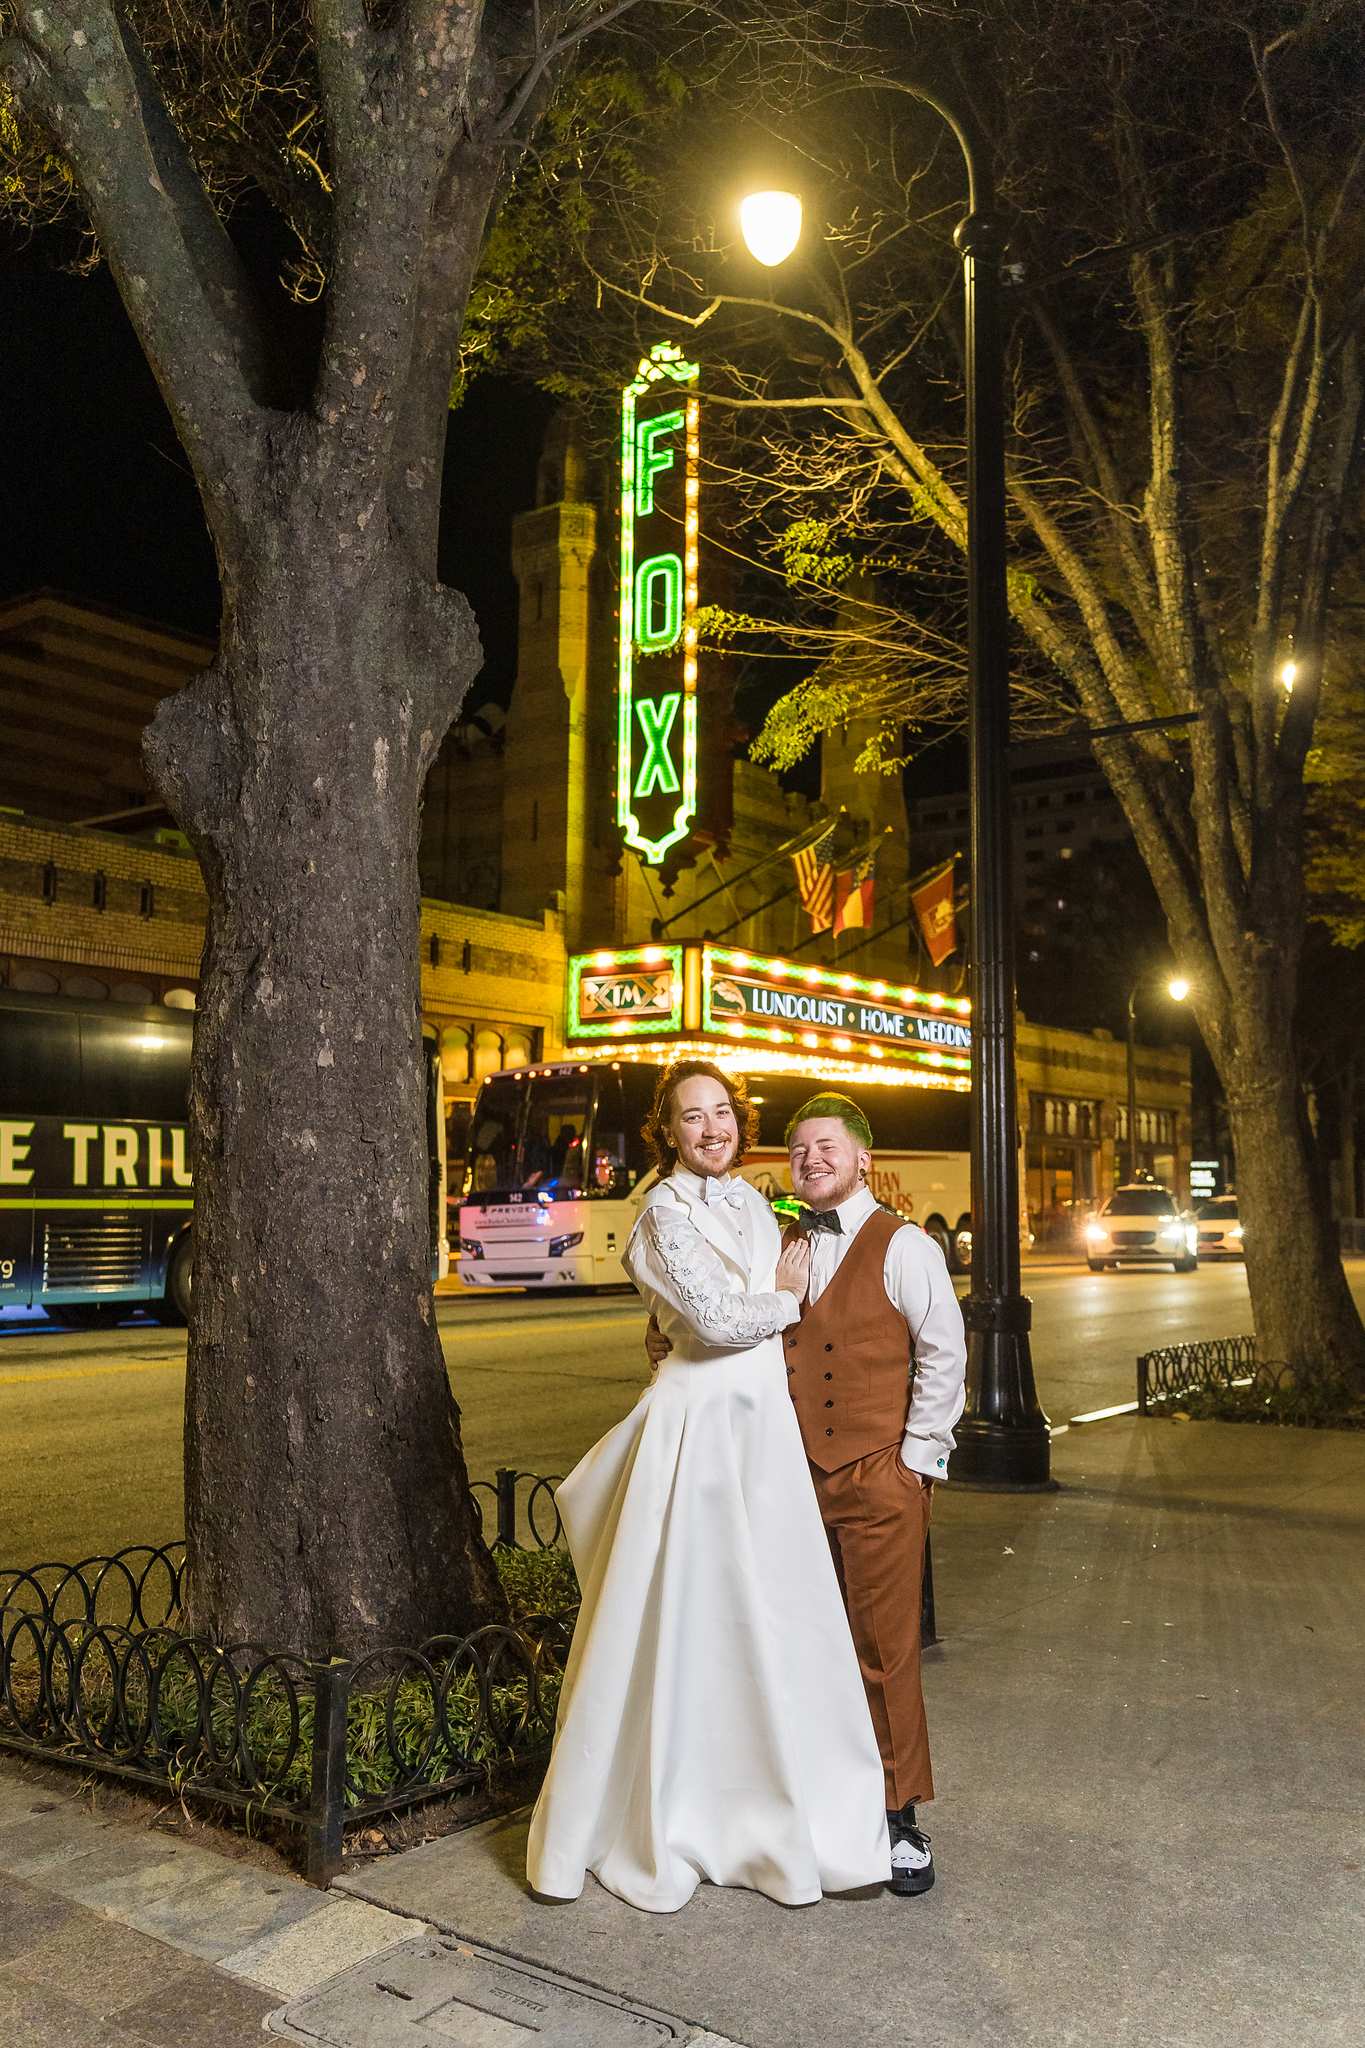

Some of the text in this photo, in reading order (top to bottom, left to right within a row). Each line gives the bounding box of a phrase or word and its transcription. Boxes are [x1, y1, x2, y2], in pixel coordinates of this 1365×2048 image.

[634, 409, 685, 798] FOX
[752, 988, 846, 1027] LUNDQUIST
[860, 1007, 905, 1037] HOWE
